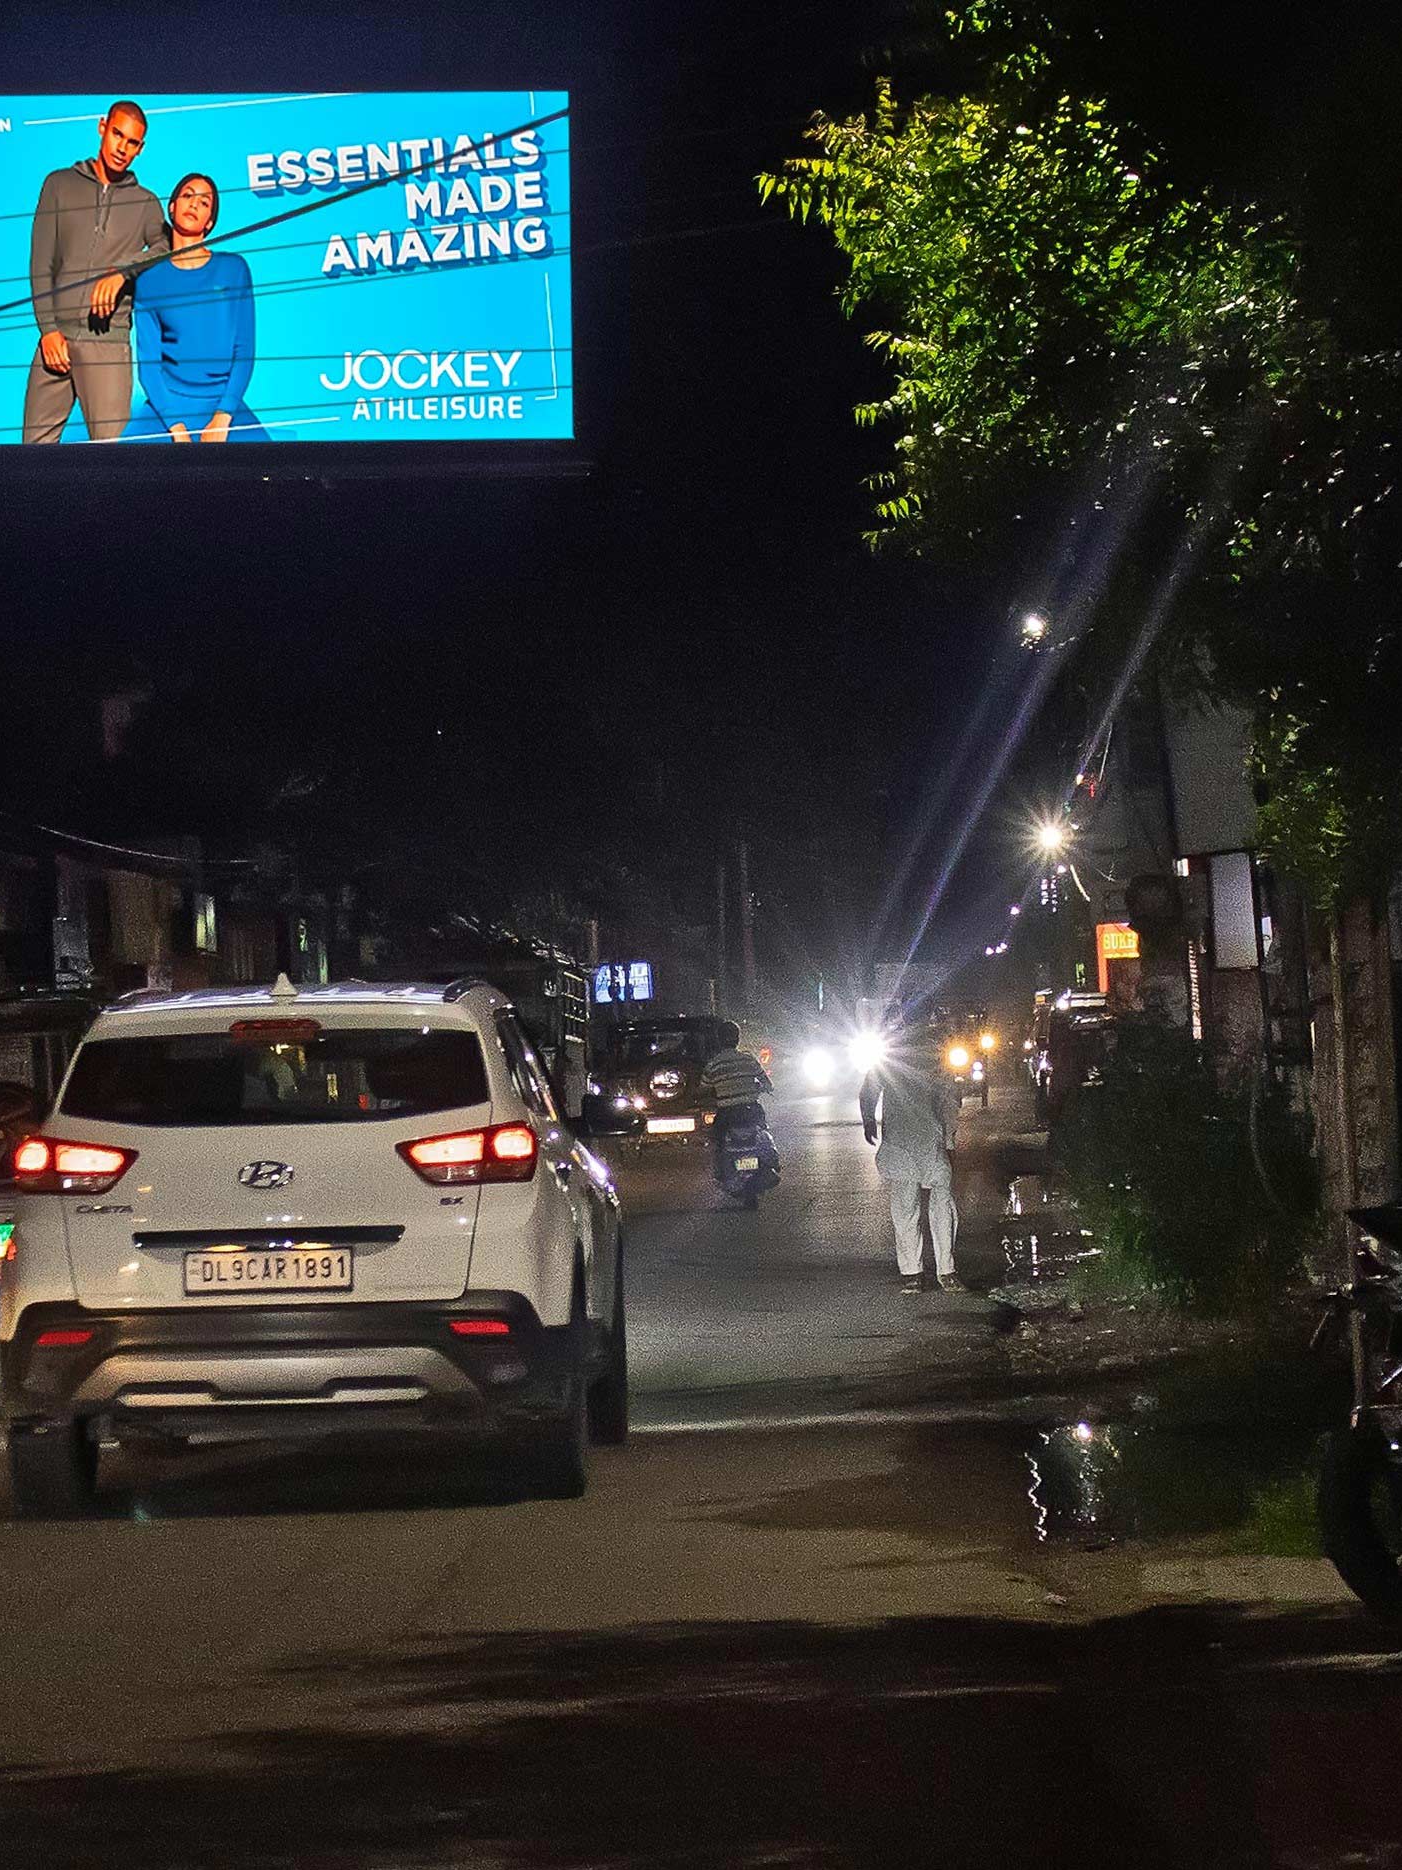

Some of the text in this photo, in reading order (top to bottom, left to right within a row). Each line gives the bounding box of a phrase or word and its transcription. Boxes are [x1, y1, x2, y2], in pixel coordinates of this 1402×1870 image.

[246, 129, 541, 193] ESSENTIALS
[404, 170, 545, 220] MADE
[321, 216, 547, 273] AMAZING
[319, 349, 523, 391] JOCKEY
[352, 395, 524, 421] ATHLEISURE
[201, 1255, 346, 1283] DL9CAR1891
